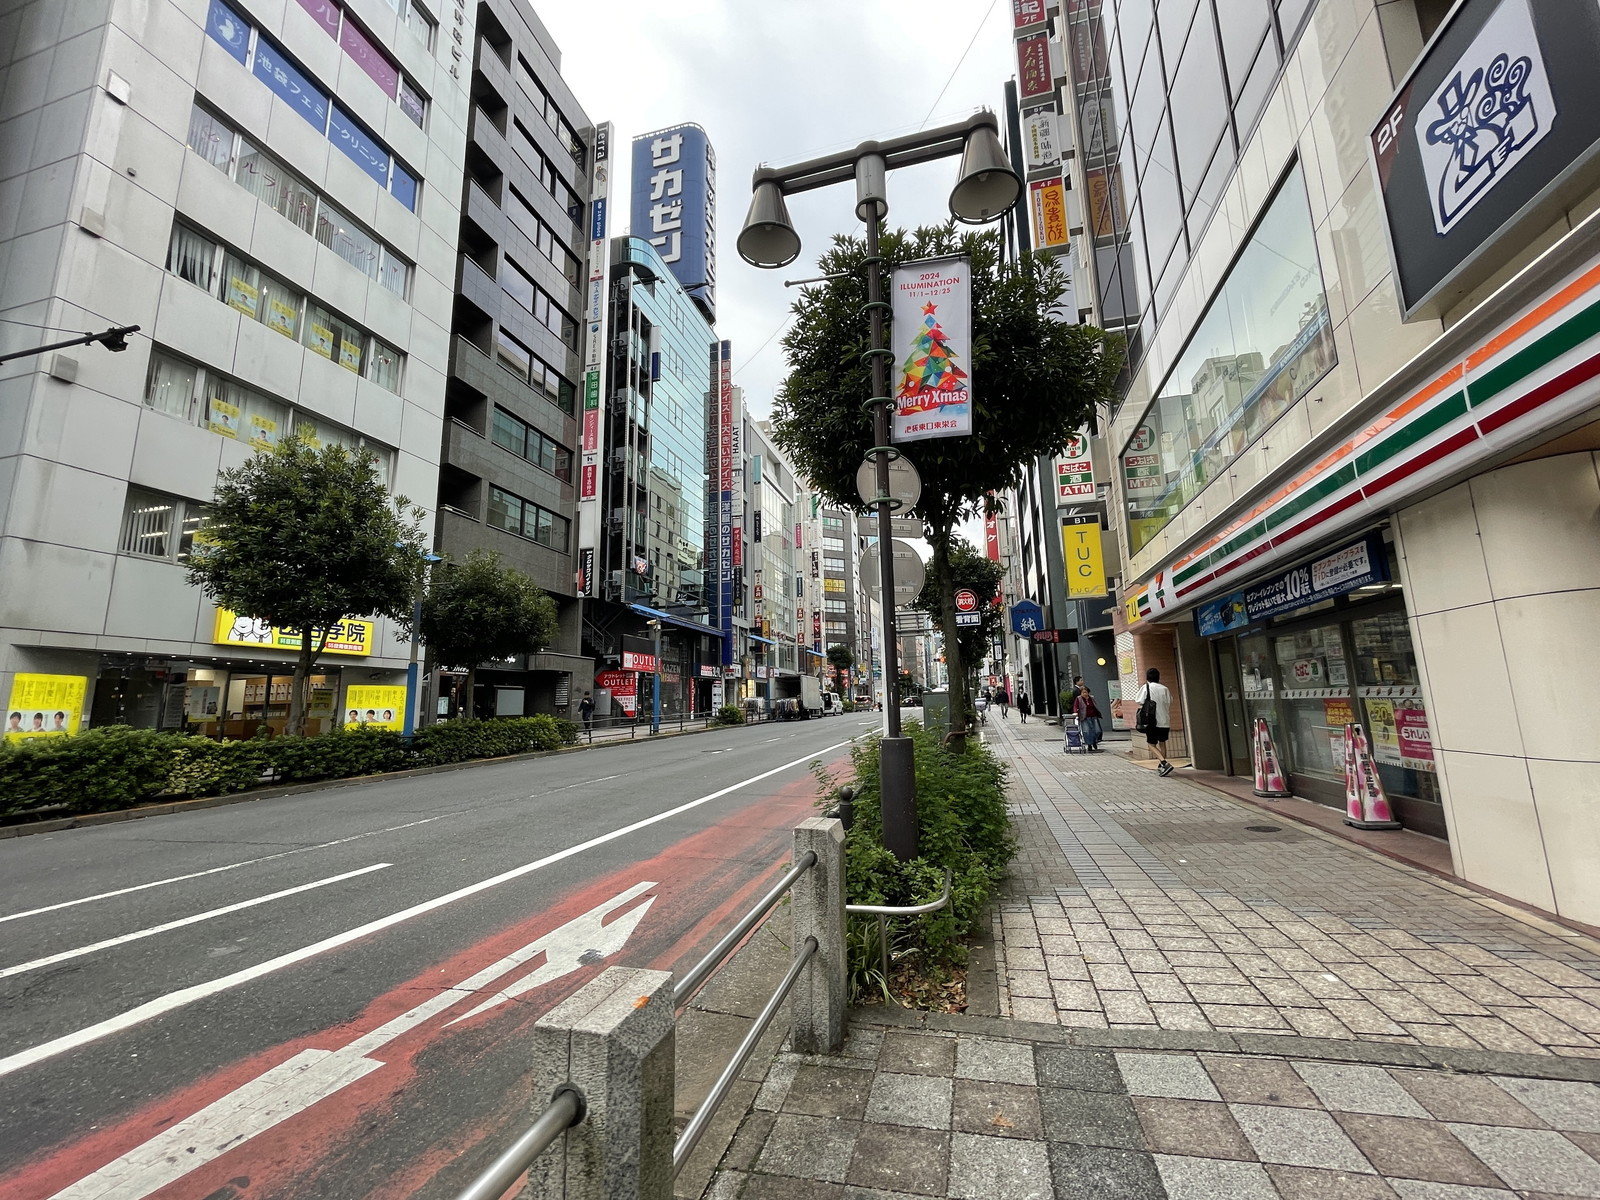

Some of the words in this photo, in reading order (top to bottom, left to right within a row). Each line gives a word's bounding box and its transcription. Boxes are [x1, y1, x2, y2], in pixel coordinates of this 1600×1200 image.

[1022, 14, 1037, 24] 7F
[1378, 105, 1403, 155] 2F
[597, 125, 608, 159] Terra
[649, 134, 684, 263] サカゼン
[1036, 192, 1045, 241] TORIKIZOKU
[1045, 190, 1064, 242] 鳥貴族
[900, 277, 960, 291] ILLUMINATION
[920, 272, 940, 281] 2024
[897, 391, 932, 410] Merry
[932, 389, 968, 405] Xmas
[1062, 463, 1089, 474] たばこ
[1069, 474, 1082, 484] 酒
[1063, 484, 1092, 495] ATM
[1074, 517, 1086, 525] B1
[721, 501, 731, 582] 洋服のサカゼン
[1076, 531, 1092, 578] TUC
[1295, 664, 1310, 677] たばこ
